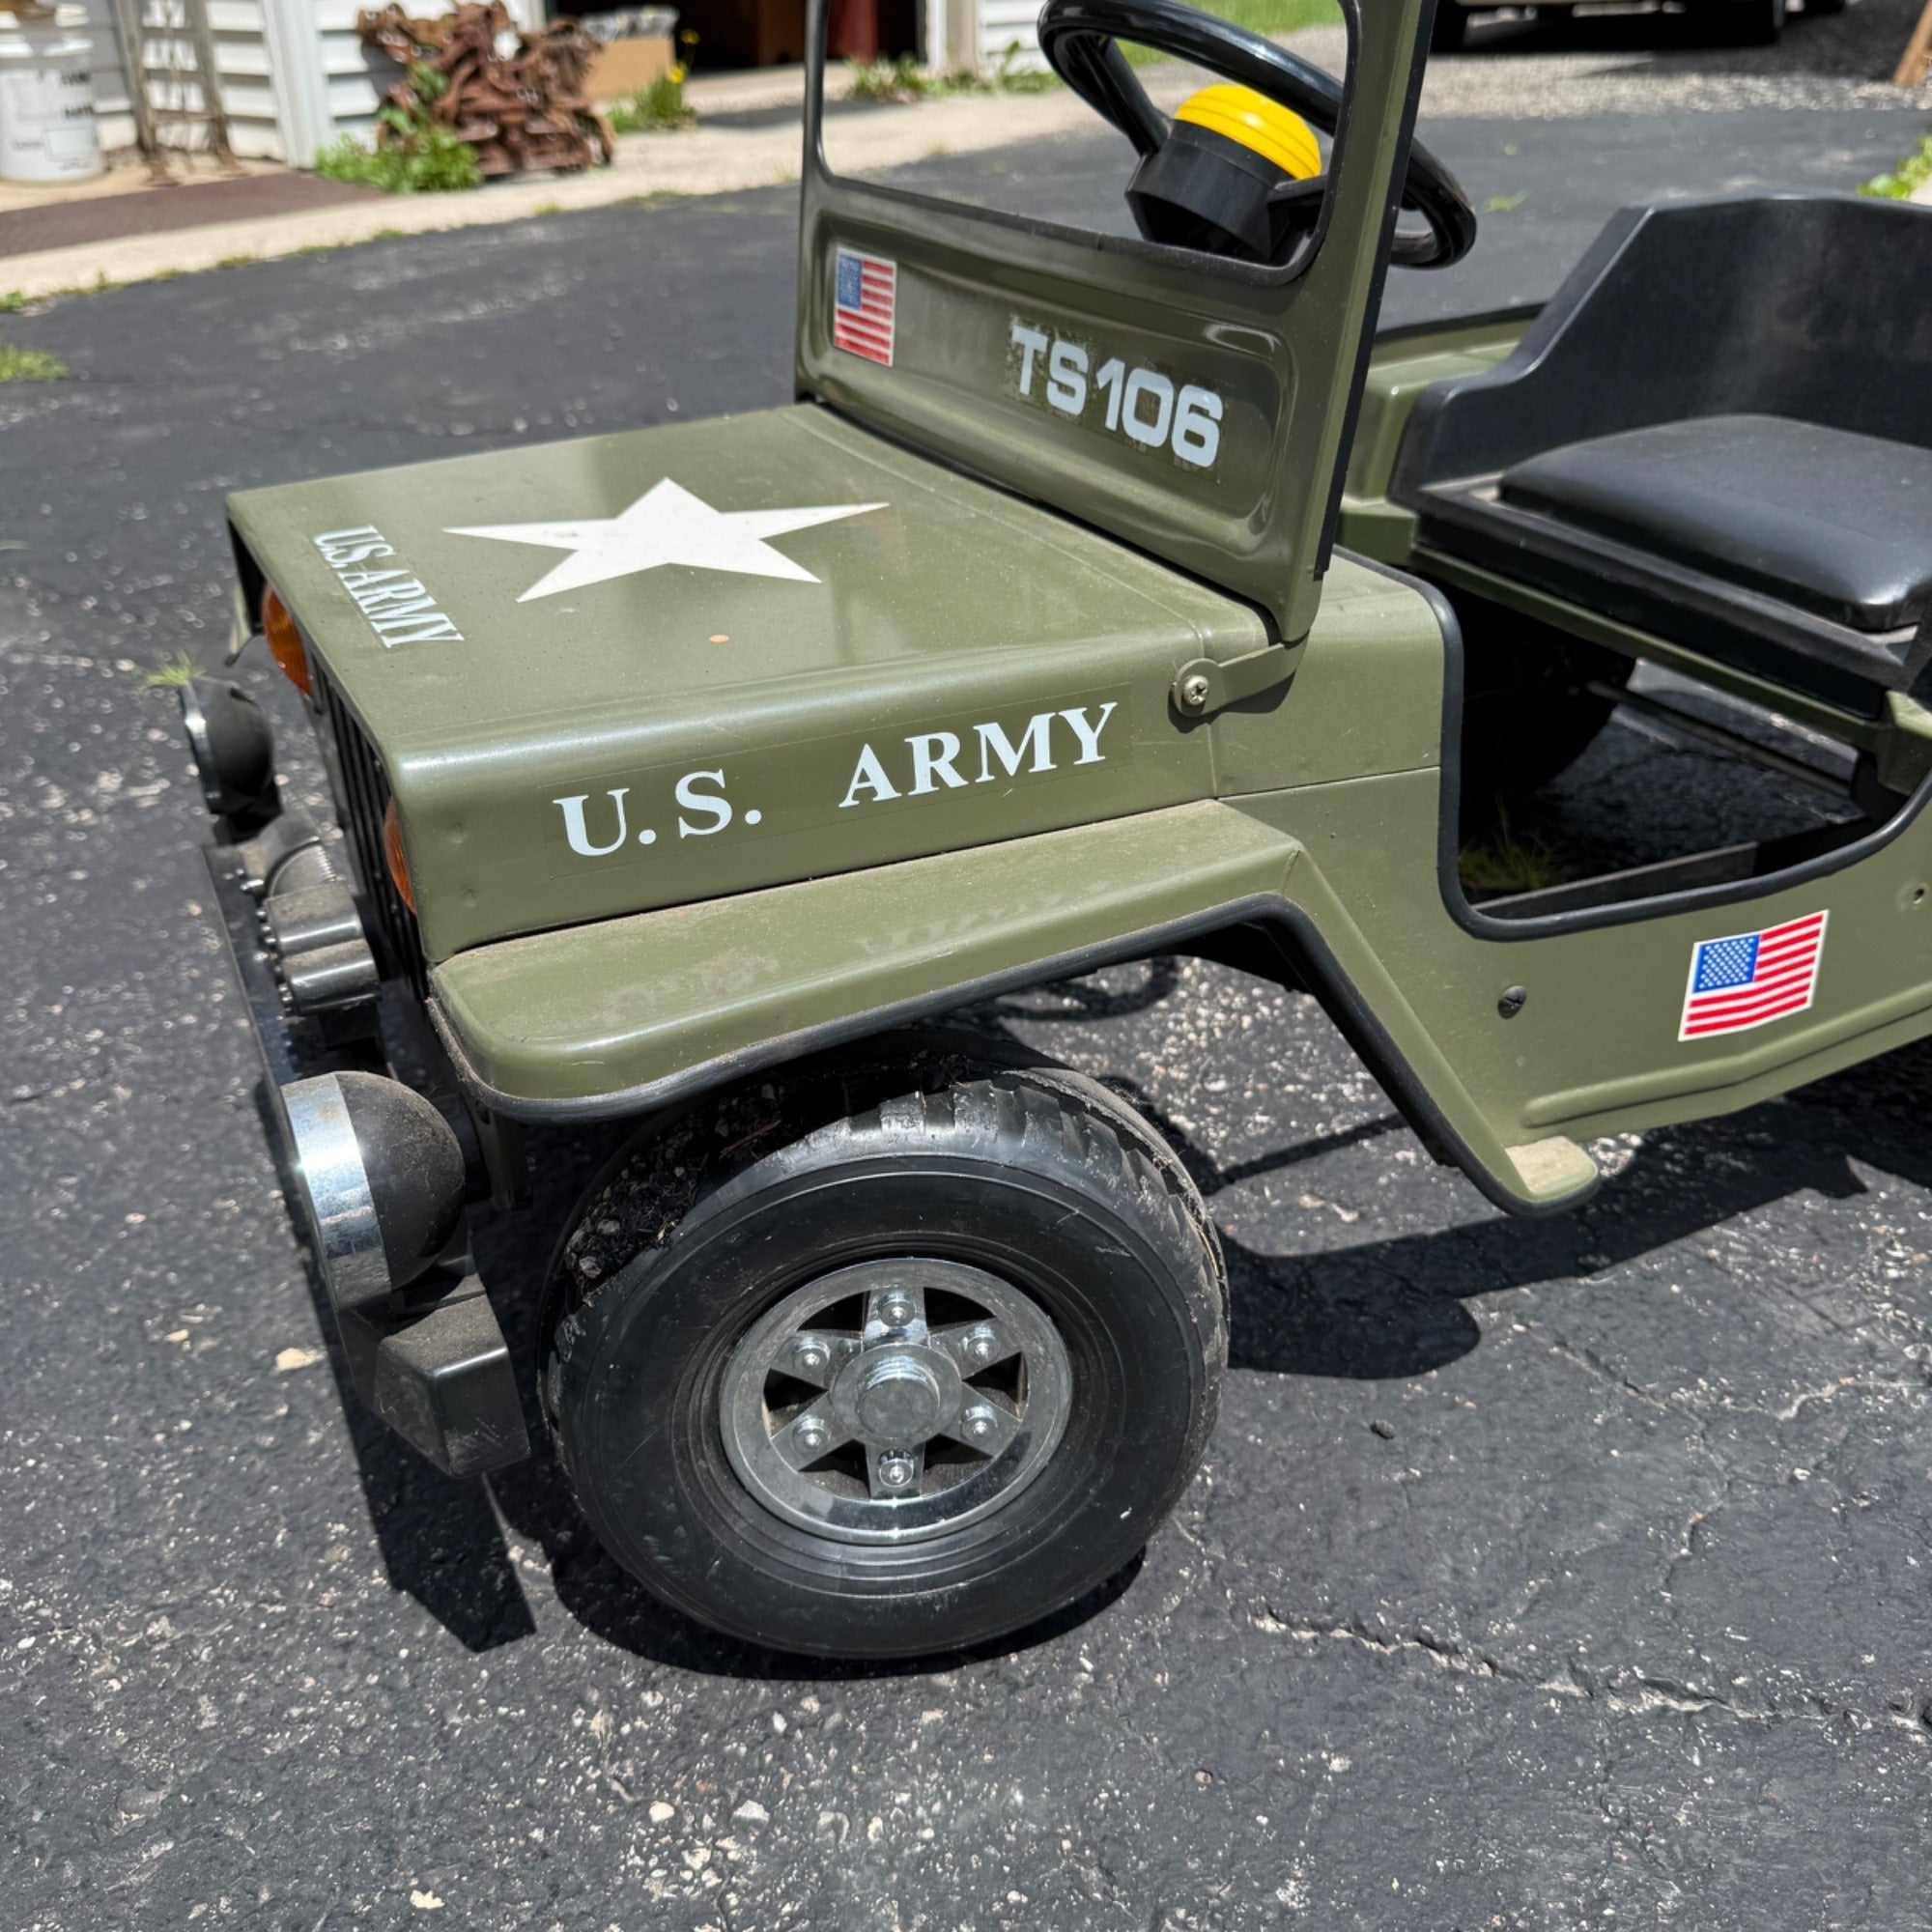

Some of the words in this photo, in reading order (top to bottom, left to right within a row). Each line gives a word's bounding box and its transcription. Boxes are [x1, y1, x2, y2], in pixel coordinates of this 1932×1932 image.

[1011, 324, 1223, 469] TS106
[313, 524, 398, 569] U.S.
[336, 568, 466, 649] ARMY
[553, 769, 763, 858] U.S.
[838, 701, 1119, 809] ARMY
